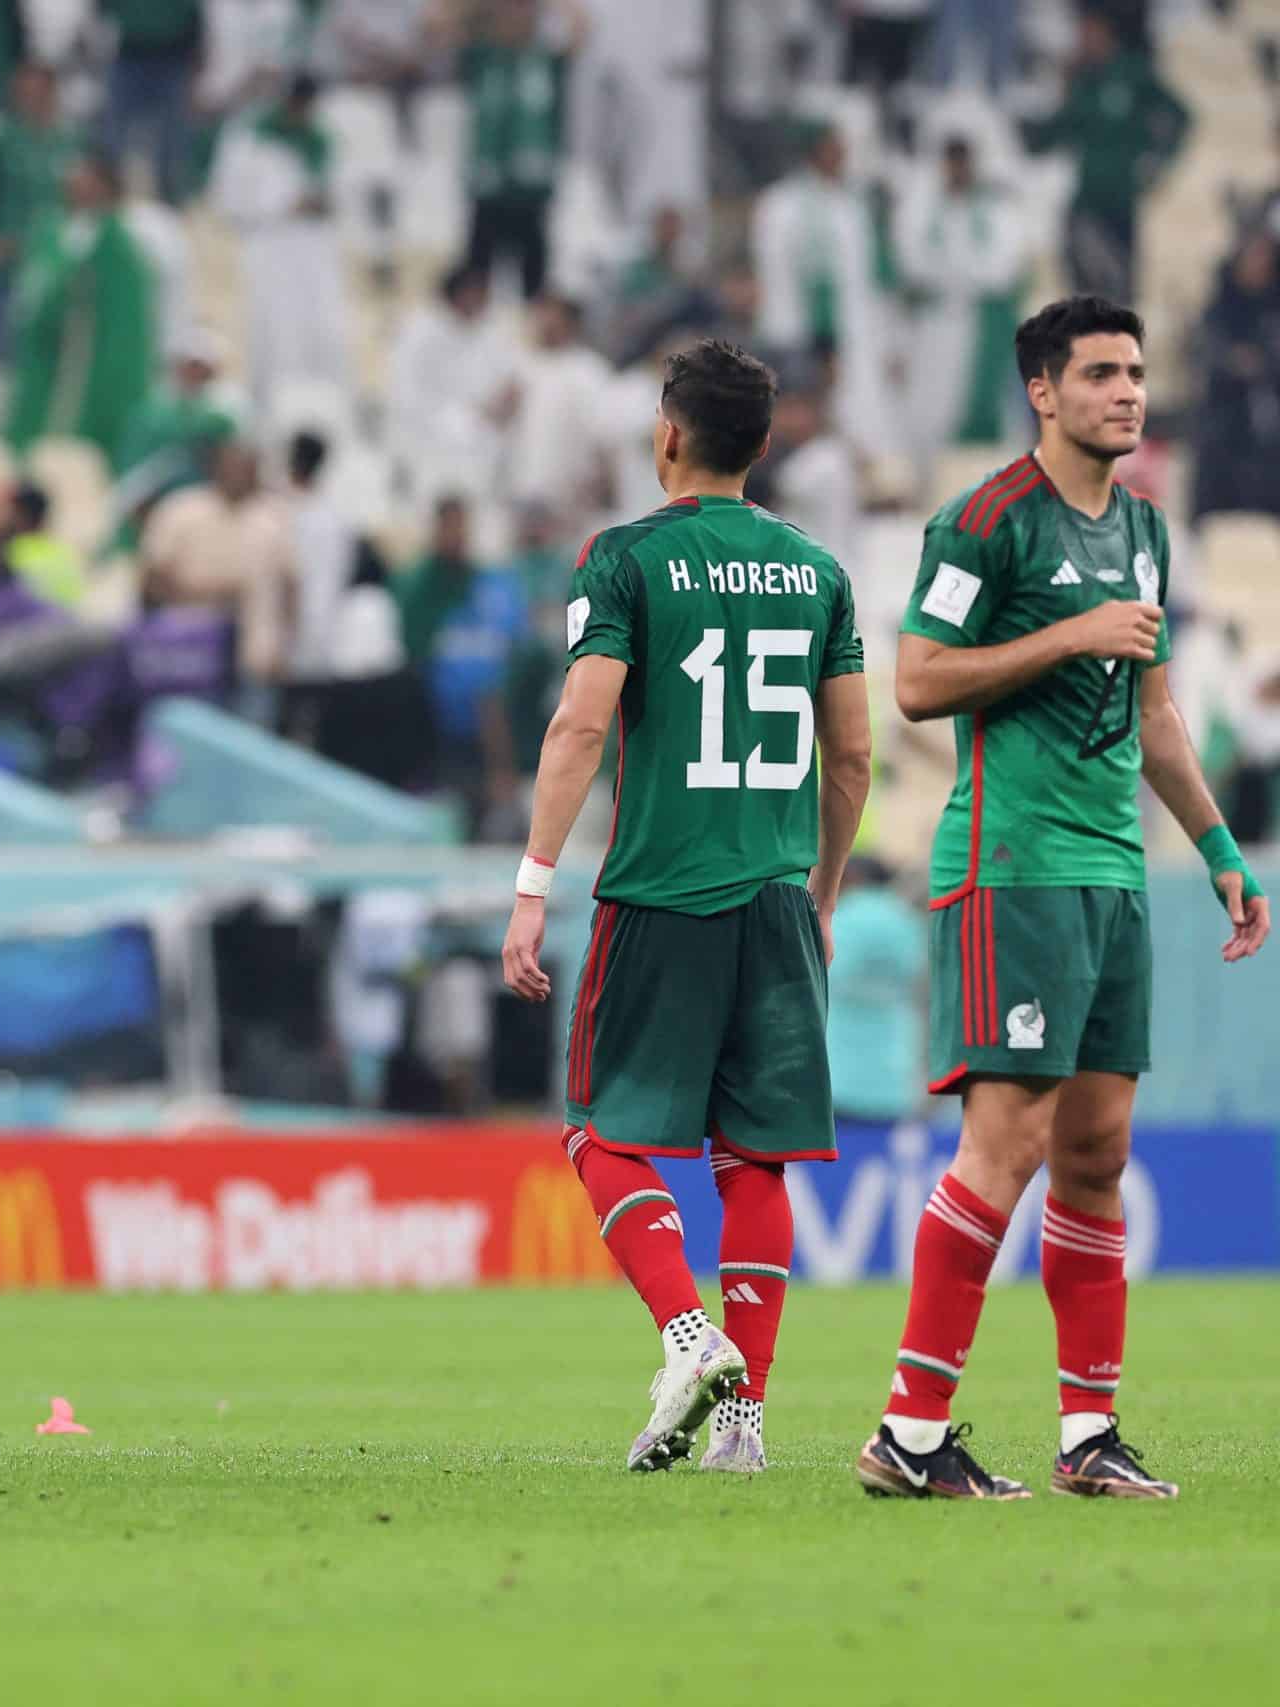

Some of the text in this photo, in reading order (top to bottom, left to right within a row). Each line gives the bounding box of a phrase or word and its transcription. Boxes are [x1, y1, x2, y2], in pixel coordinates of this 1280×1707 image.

[668, 559, 817, 596] H. MORENO
[679, 628, 816, 790] 15
[83, 1169, 490, 1292] We Deliver
